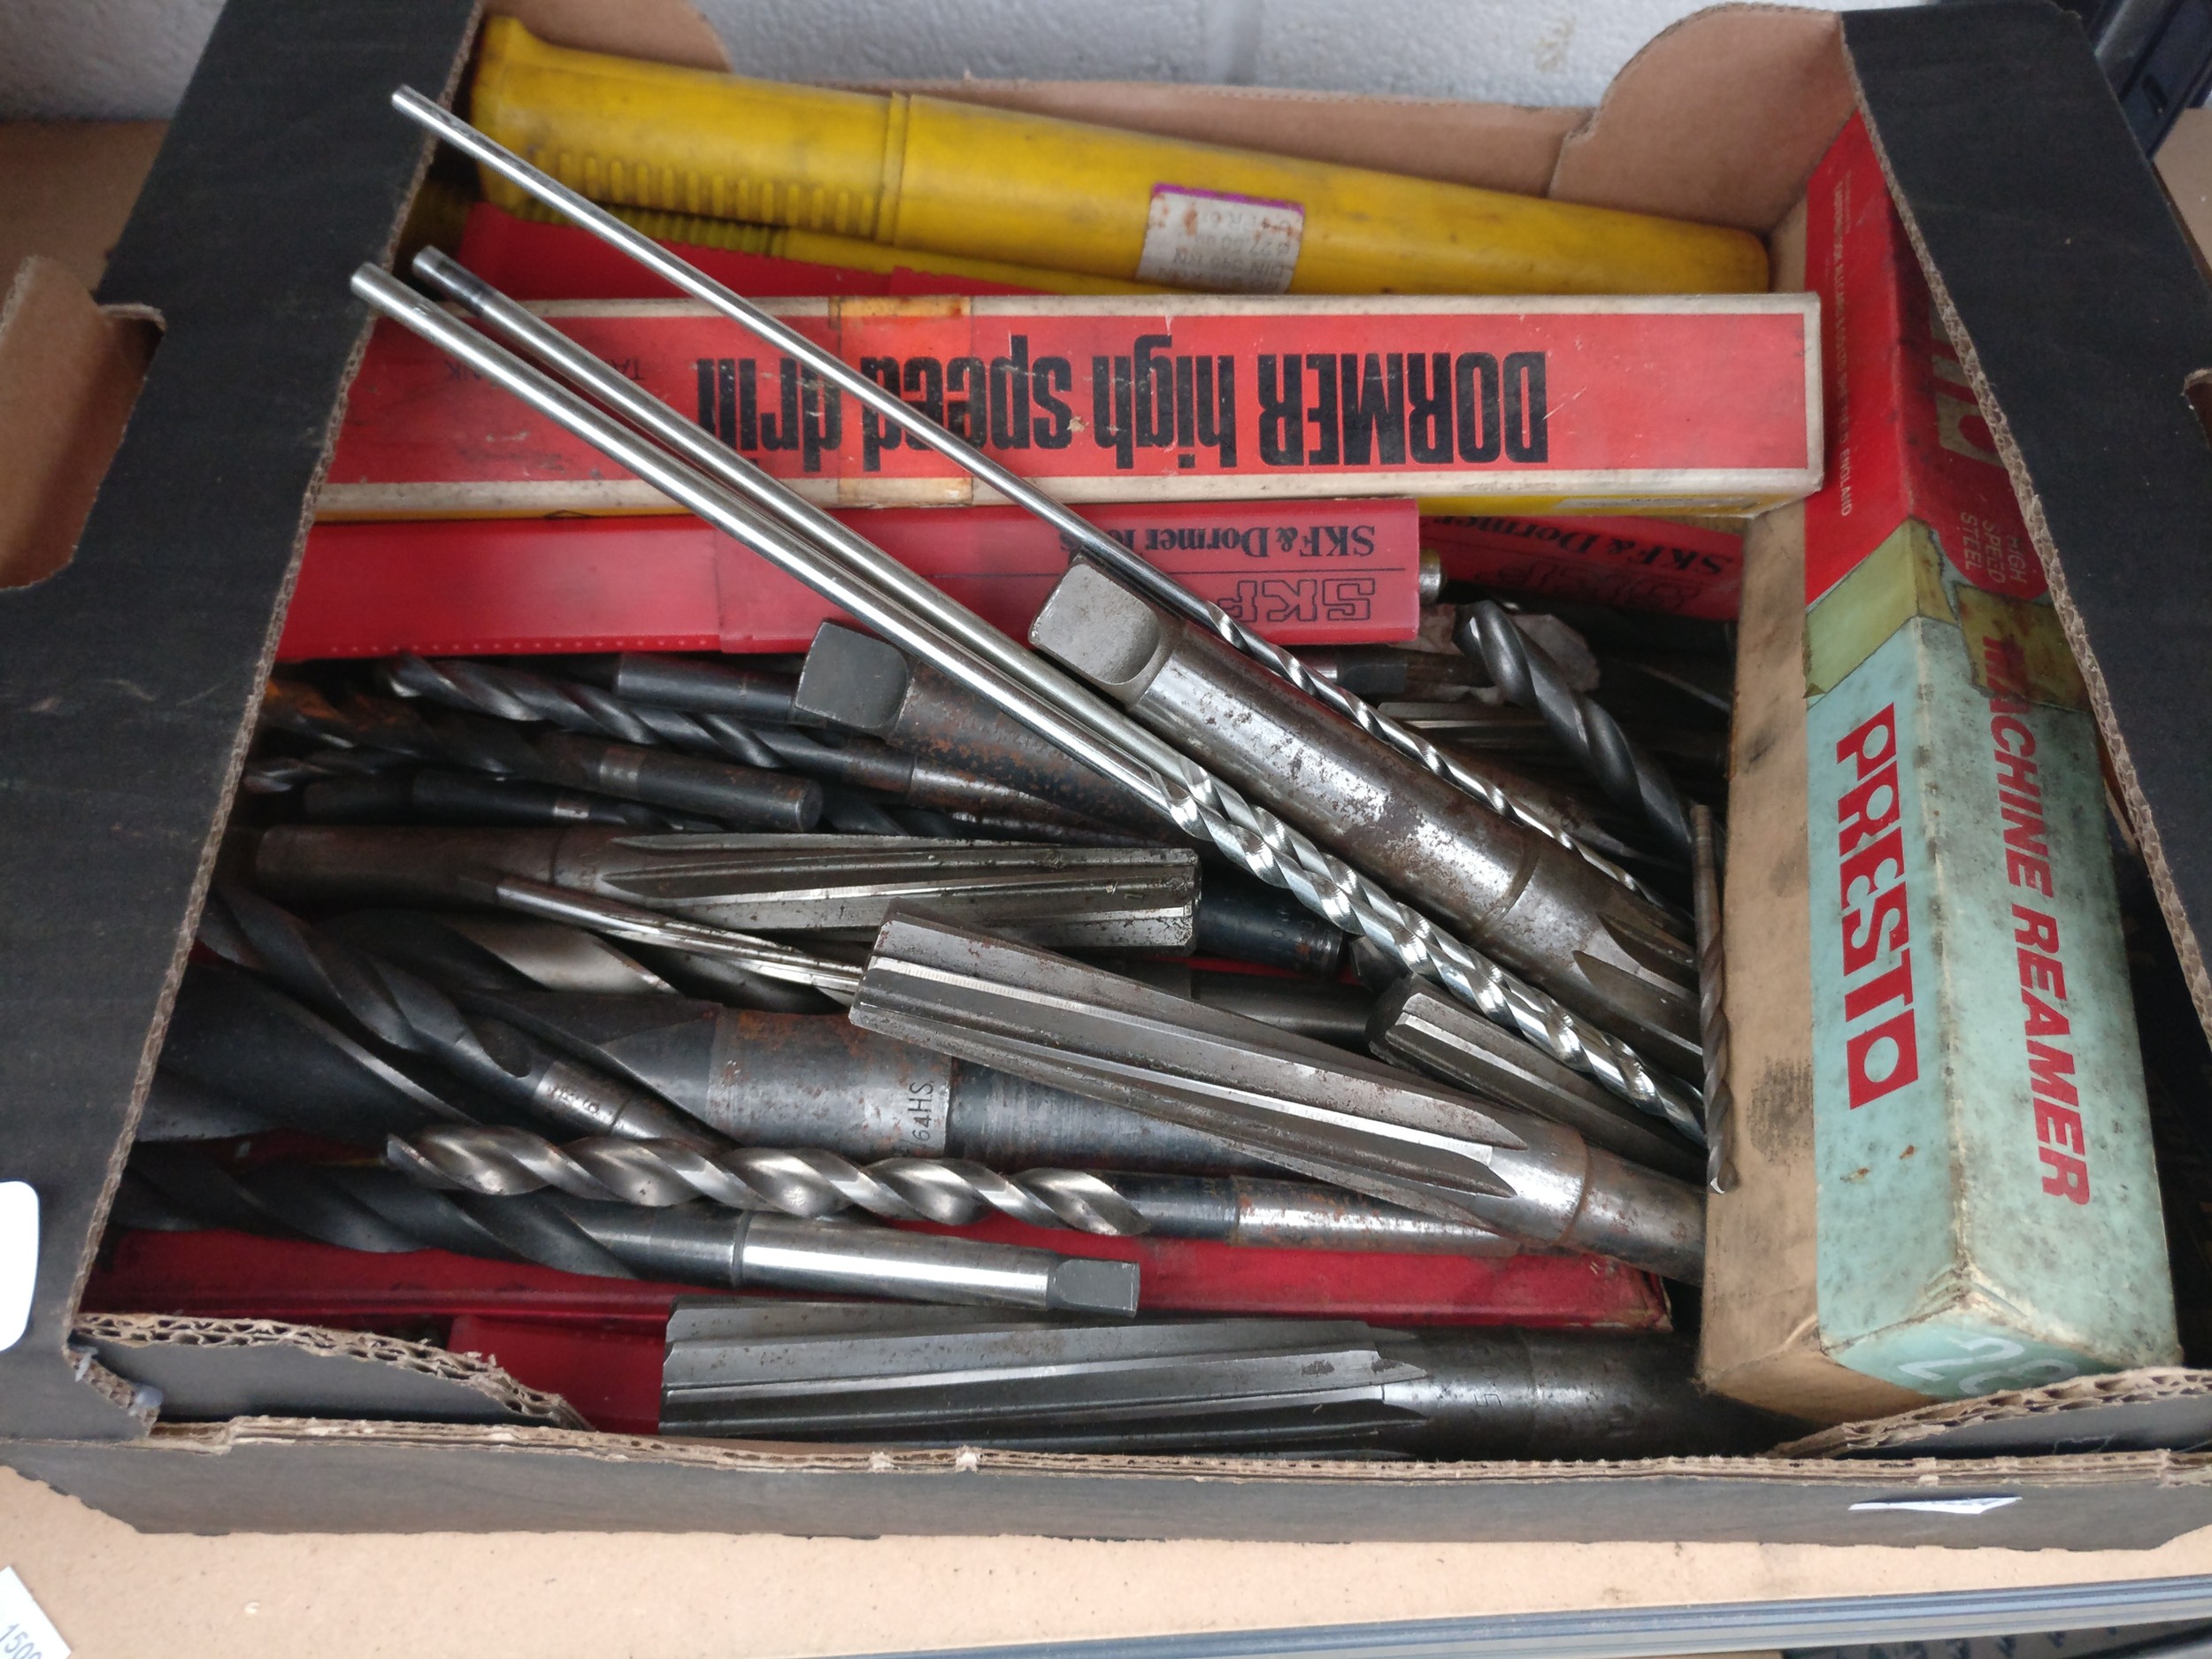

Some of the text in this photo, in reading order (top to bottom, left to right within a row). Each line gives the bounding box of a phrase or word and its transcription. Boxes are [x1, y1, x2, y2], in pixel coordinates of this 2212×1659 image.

[859, 334, 1074, 472] speed
[1091, 334, 1239, 471] high
[1256, 351, 1549, 467] DORMER
[1145, 526, 1271, 559] Dormer
[1299, 525, 1377, 558] SKF
[1959, 511, 1983, 572] STEEL
[1981, 518, 2007, 584] SPEED
[2006, 534, 2028, 584] HIGH
[1216, 577, 1377, 624] SKF
[1834, 701, 1921, 1111] PRESTO
[1981, 634, 2092, 1208] MACHINE REAMER
